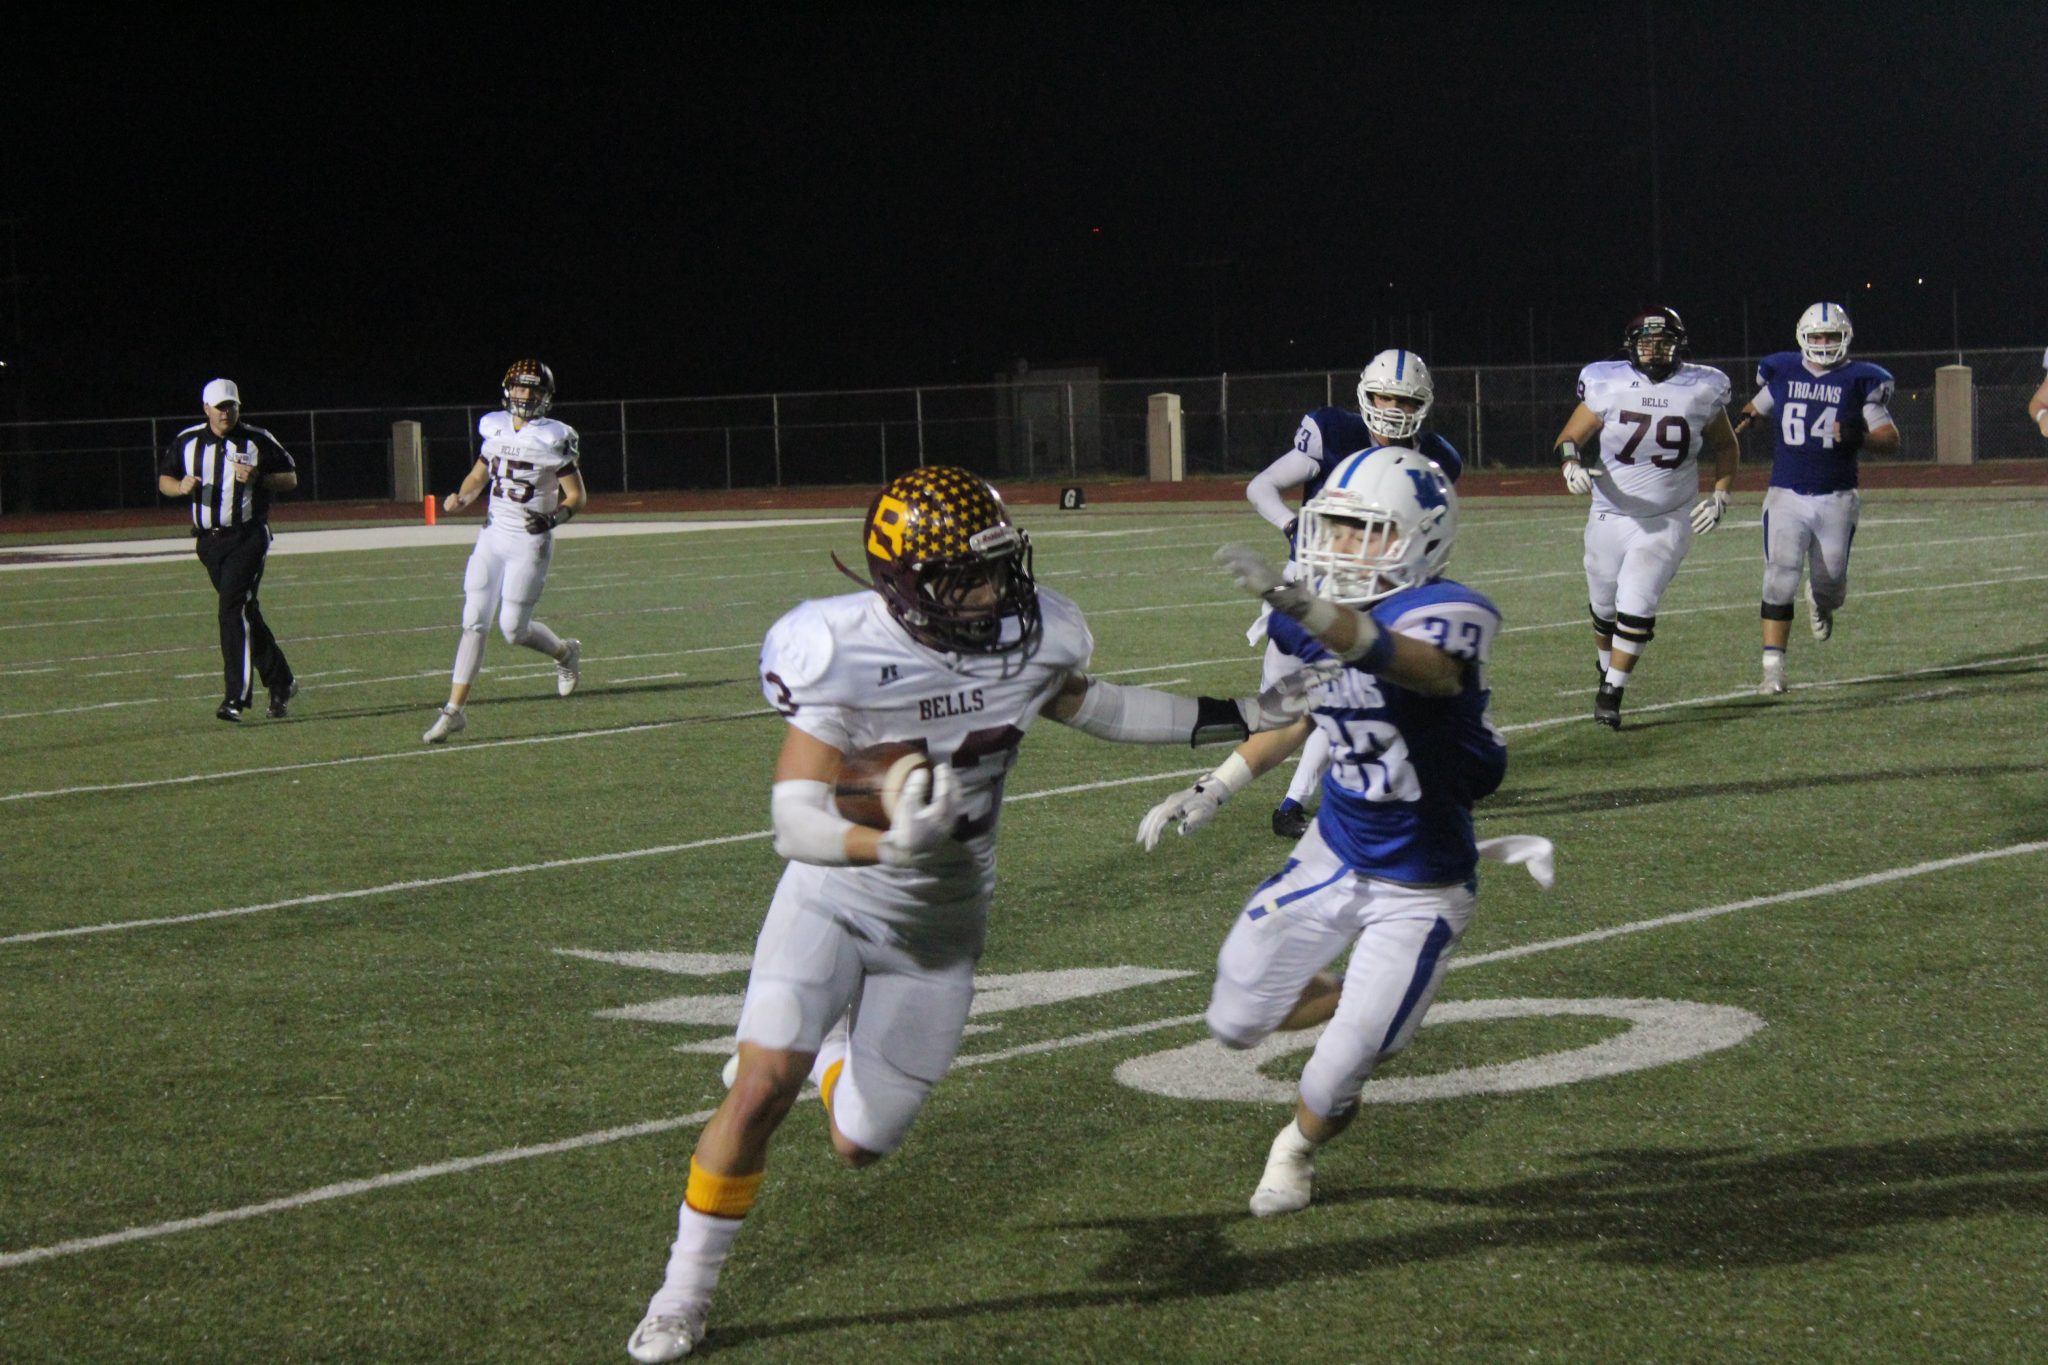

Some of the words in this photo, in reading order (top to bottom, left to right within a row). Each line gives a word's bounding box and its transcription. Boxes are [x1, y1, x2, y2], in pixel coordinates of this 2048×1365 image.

[1641, 397, 1669, 408] BELLS
[1788, 381, 1842, 404] TROJANS
[1615, 410, 1691, 469] 79
[1782, 402, 1838, 448] 64
[491, 456, 535, 504] 15
[918, 688, 985, 721] BELLS
